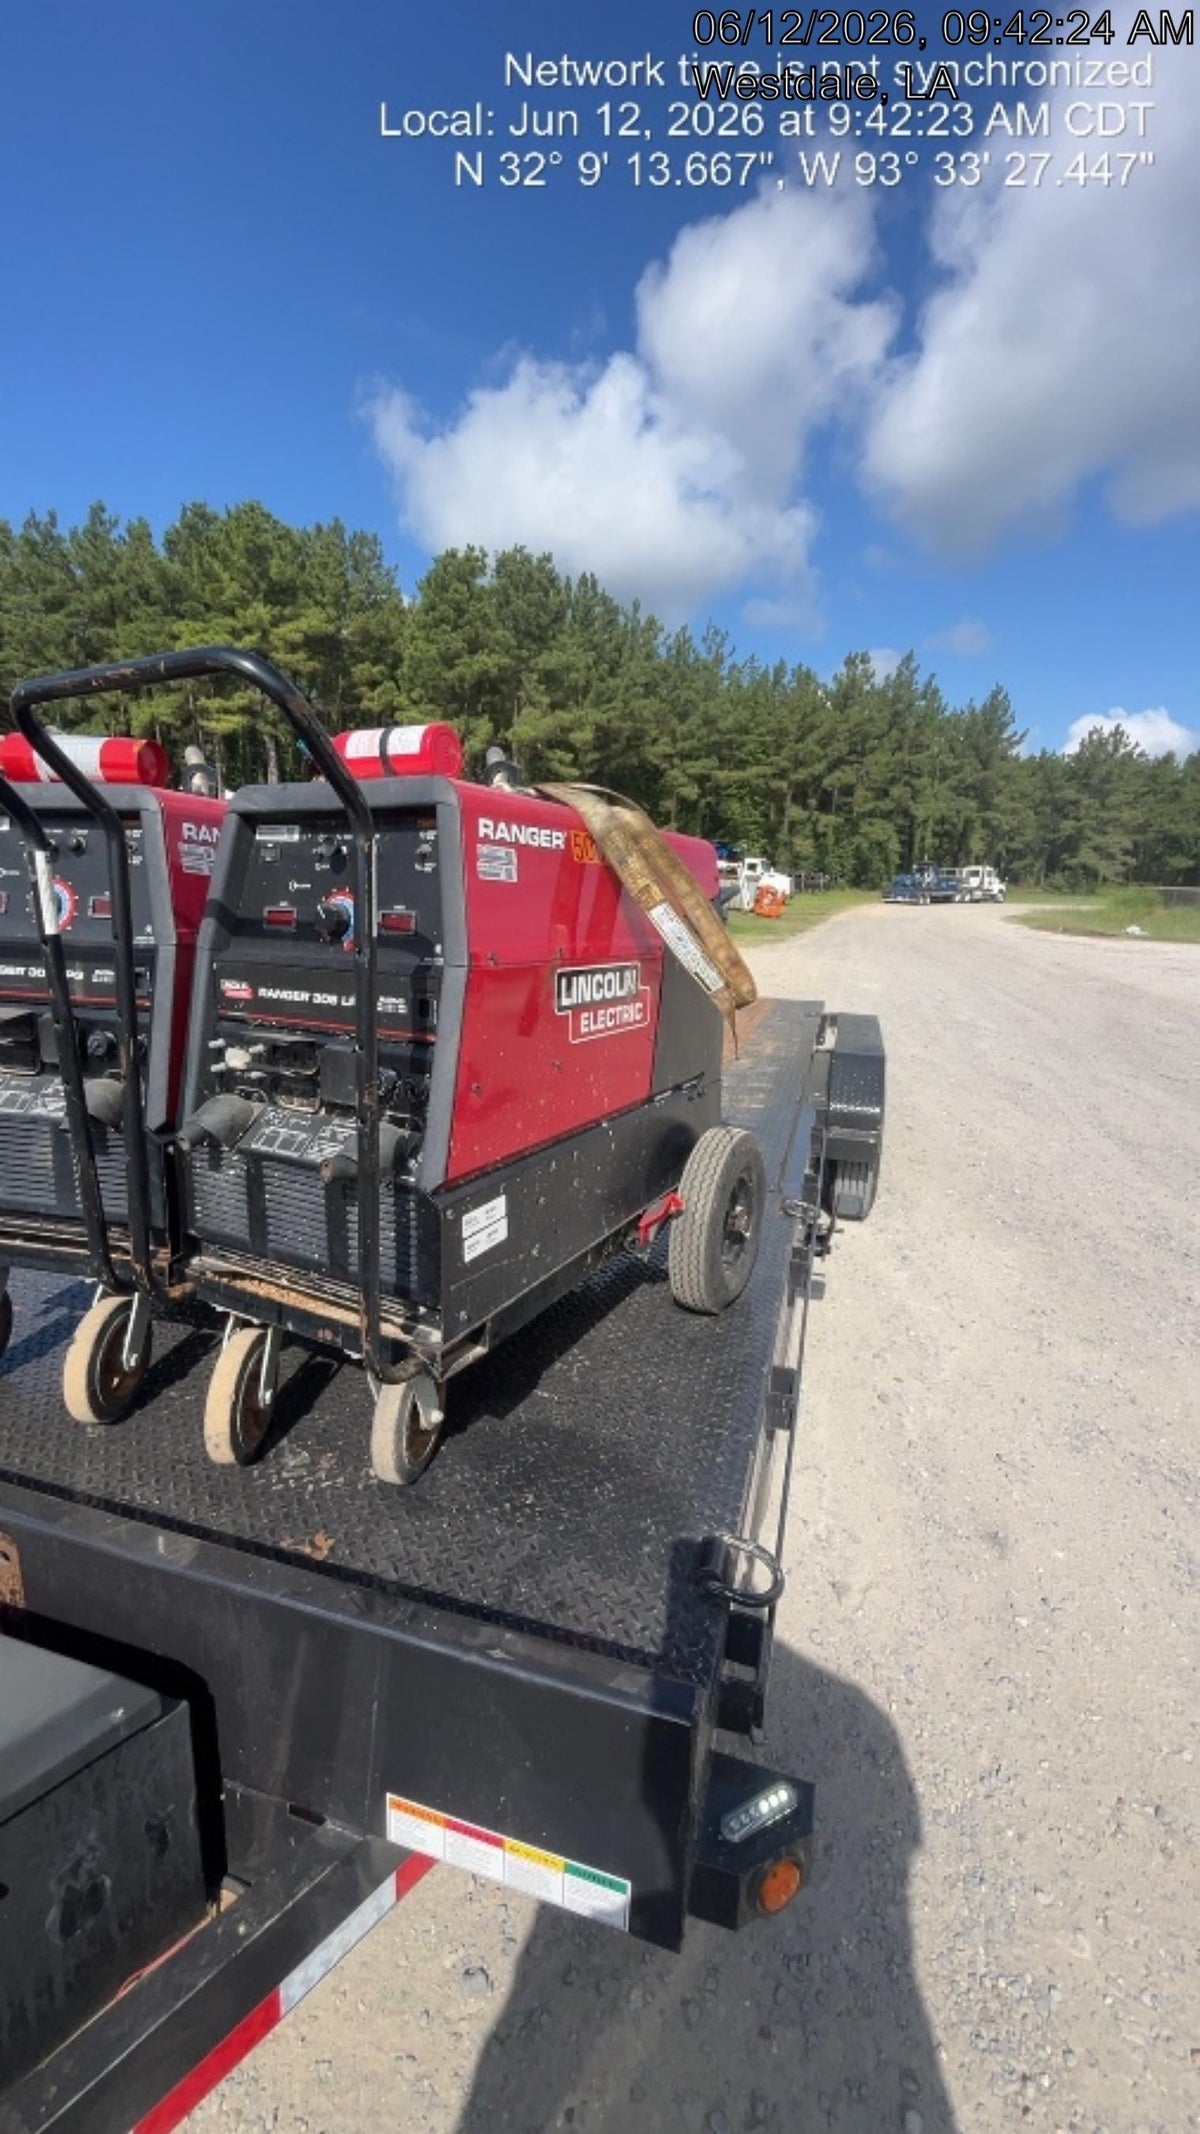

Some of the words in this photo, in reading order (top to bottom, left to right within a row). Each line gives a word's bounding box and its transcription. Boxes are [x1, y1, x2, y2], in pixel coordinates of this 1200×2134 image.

[182, 822, 221, 843] RAN
[478, 817, 566, 850] RANGER
[561, 969, 637, 1007] LINCOLN
[580, 1002, 644, 1035] ELECTRIC
